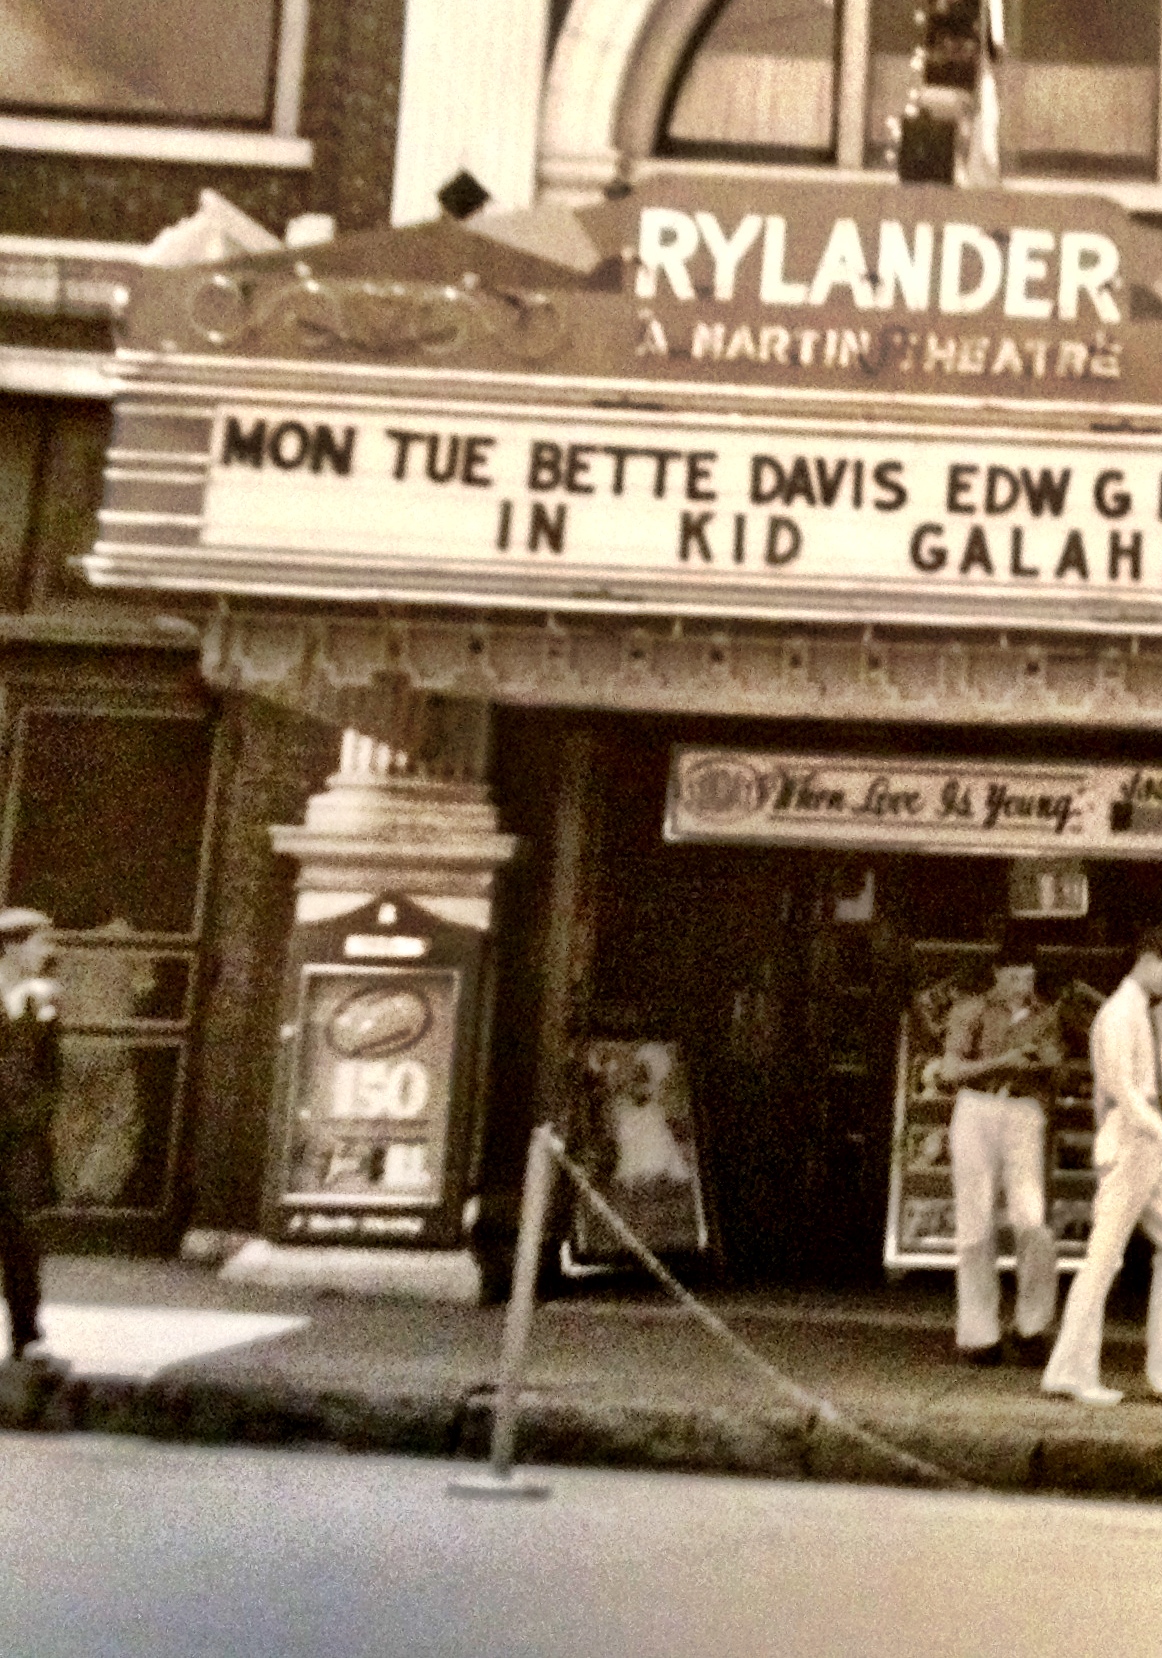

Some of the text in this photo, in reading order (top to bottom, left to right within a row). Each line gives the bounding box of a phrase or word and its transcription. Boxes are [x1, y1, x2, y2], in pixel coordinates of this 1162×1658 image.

[634, 206, 1121, 324] RYLANDER
[691, 322, 869, 369] MARTIN
[219, 415, 356, 477] MON
[385, 427, 494, 488] TUE
[527, 438, 718, 502] BETTE
[750, 454, 908, 513] DAVIS
[946, 462, 1073, 519] EDW
[1093, 467, 1133, 521] G
[497, 498, 568, 555] IN
[677, 507, 803, 568] KID
